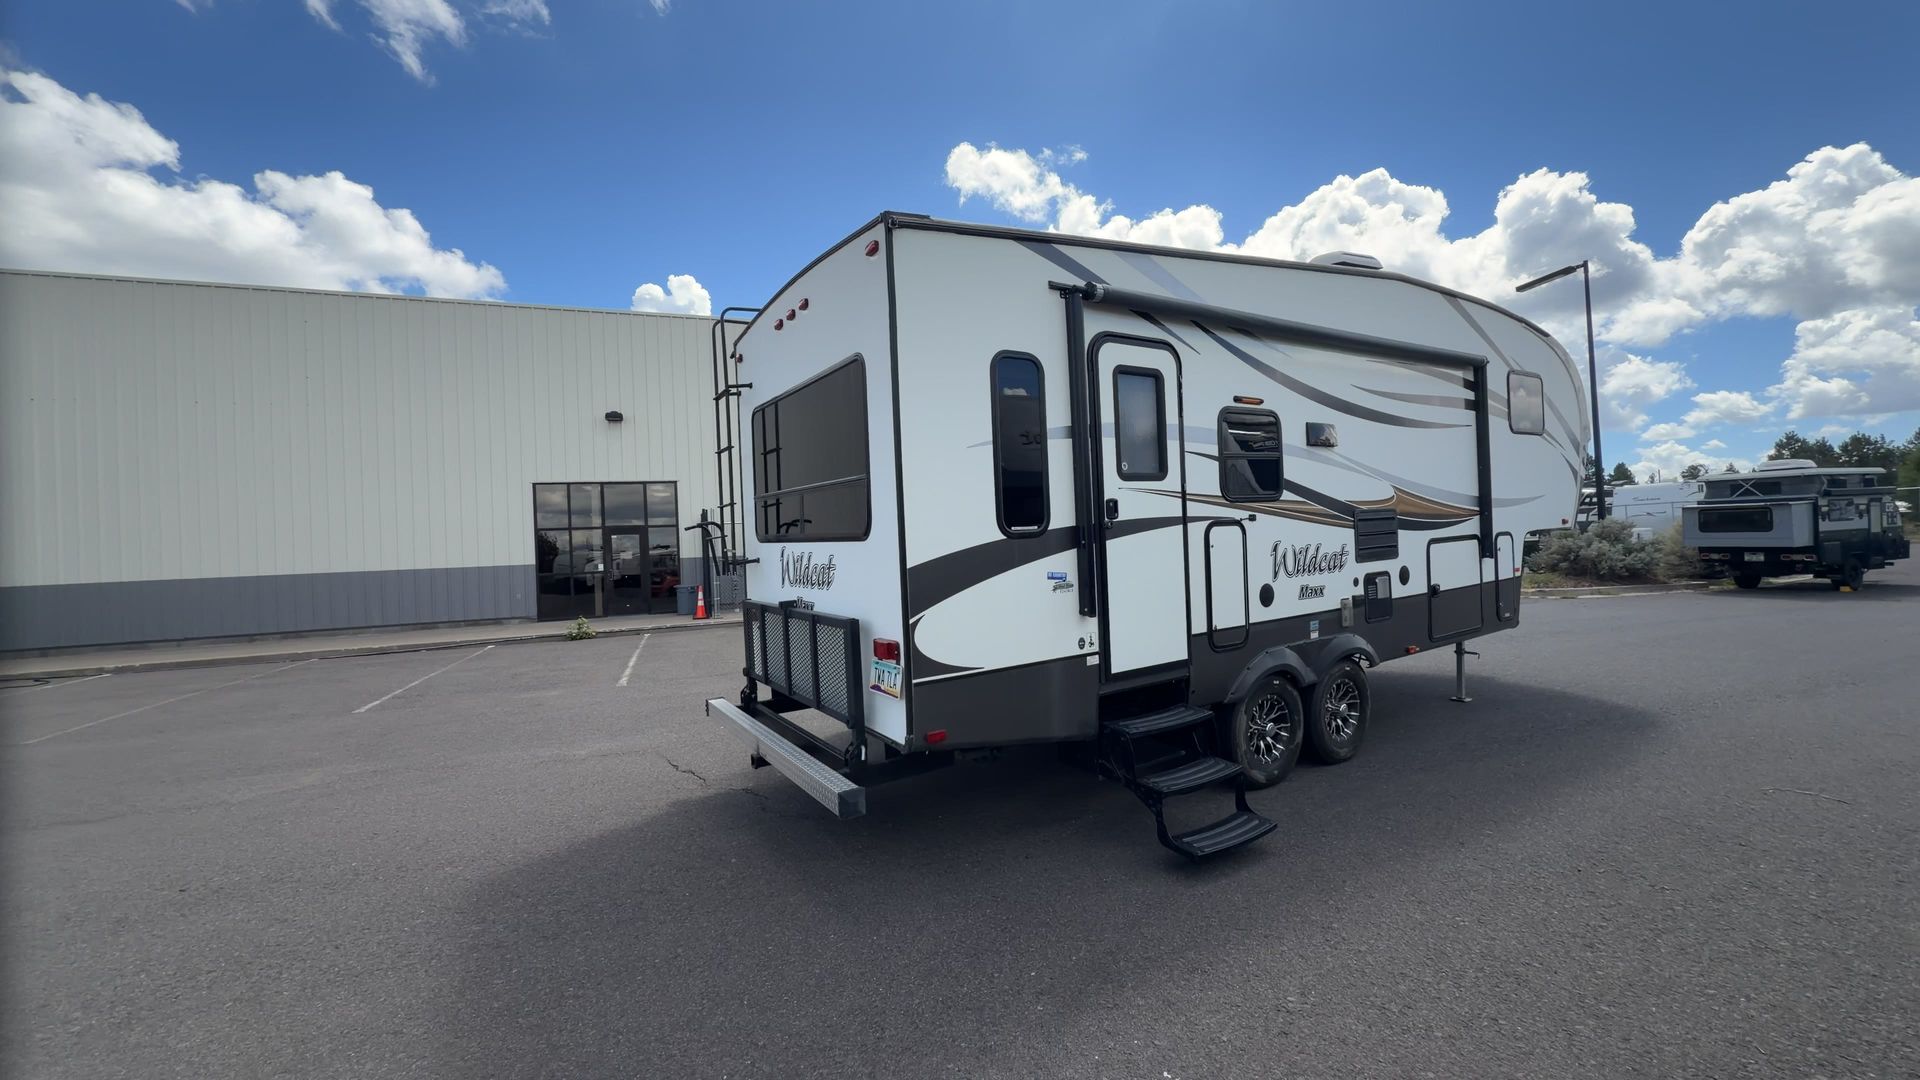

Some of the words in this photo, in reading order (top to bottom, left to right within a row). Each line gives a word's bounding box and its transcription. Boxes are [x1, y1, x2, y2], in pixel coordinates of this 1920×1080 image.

[780, 546, 836, 591] Wildcat
[1270, 540, 1349, 583] Wildcat
[1298, 584, 1326, 600] Maxx
